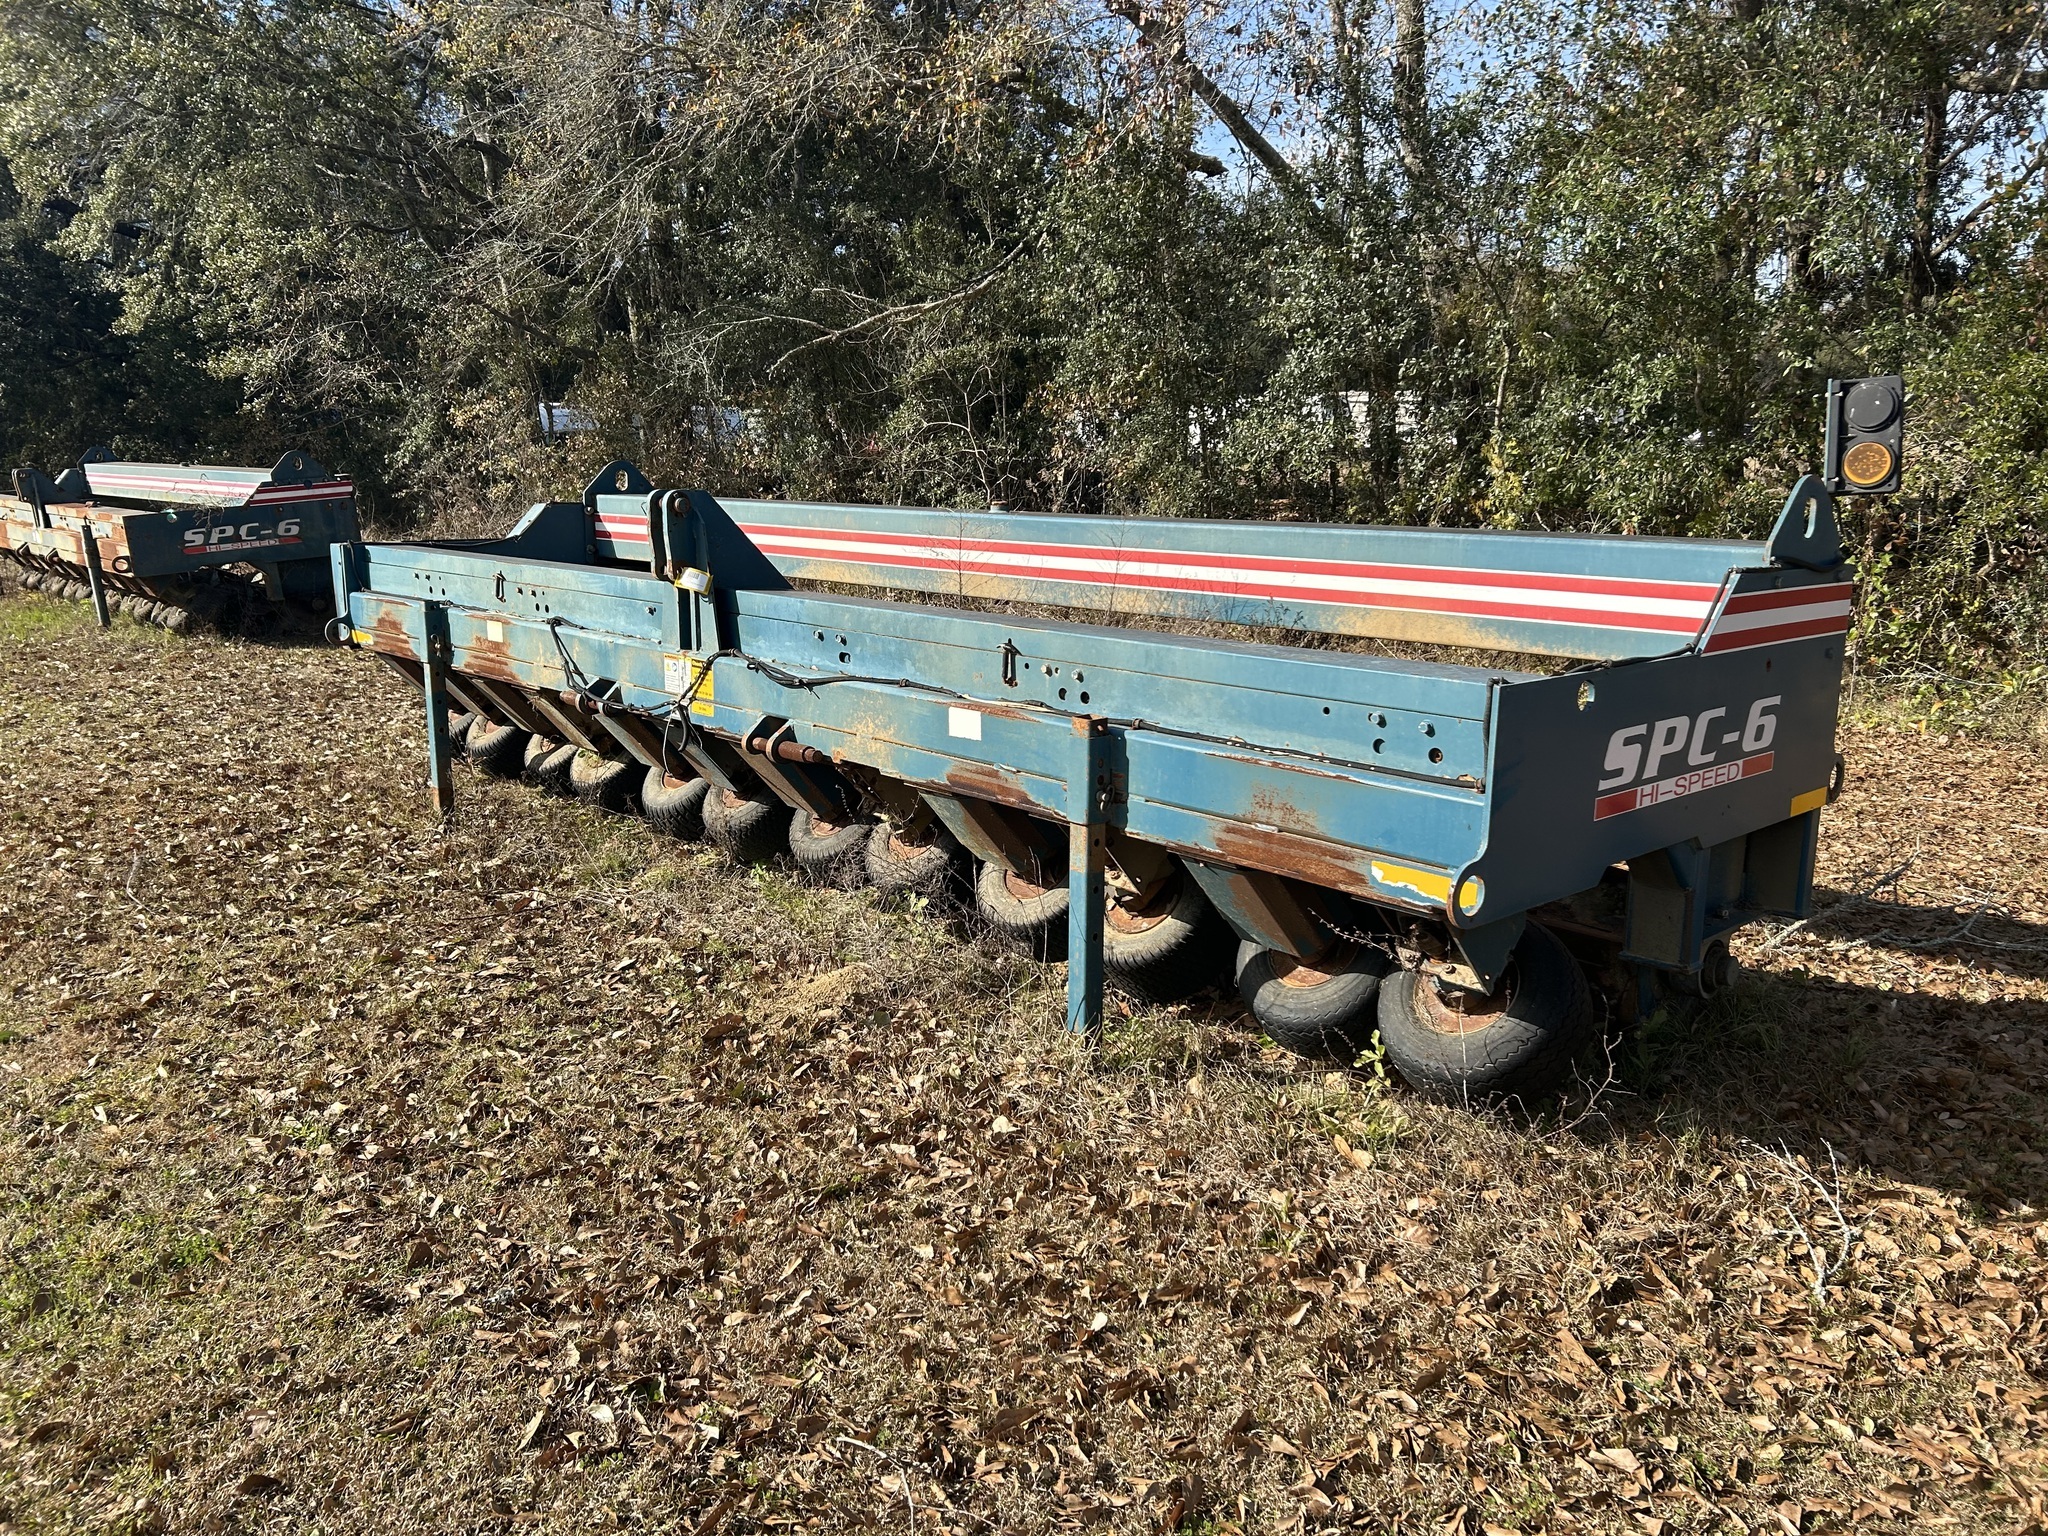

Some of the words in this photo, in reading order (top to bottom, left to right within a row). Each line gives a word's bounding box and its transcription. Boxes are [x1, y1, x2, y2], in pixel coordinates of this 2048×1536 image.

[184, 518, 300, 547] SPC-6
[208, 539, 277, 552] HI-SPEED
[1598, 695, 1782, 791] SPC-6
[1639, 762, 1740, 806] HI-SPEED
